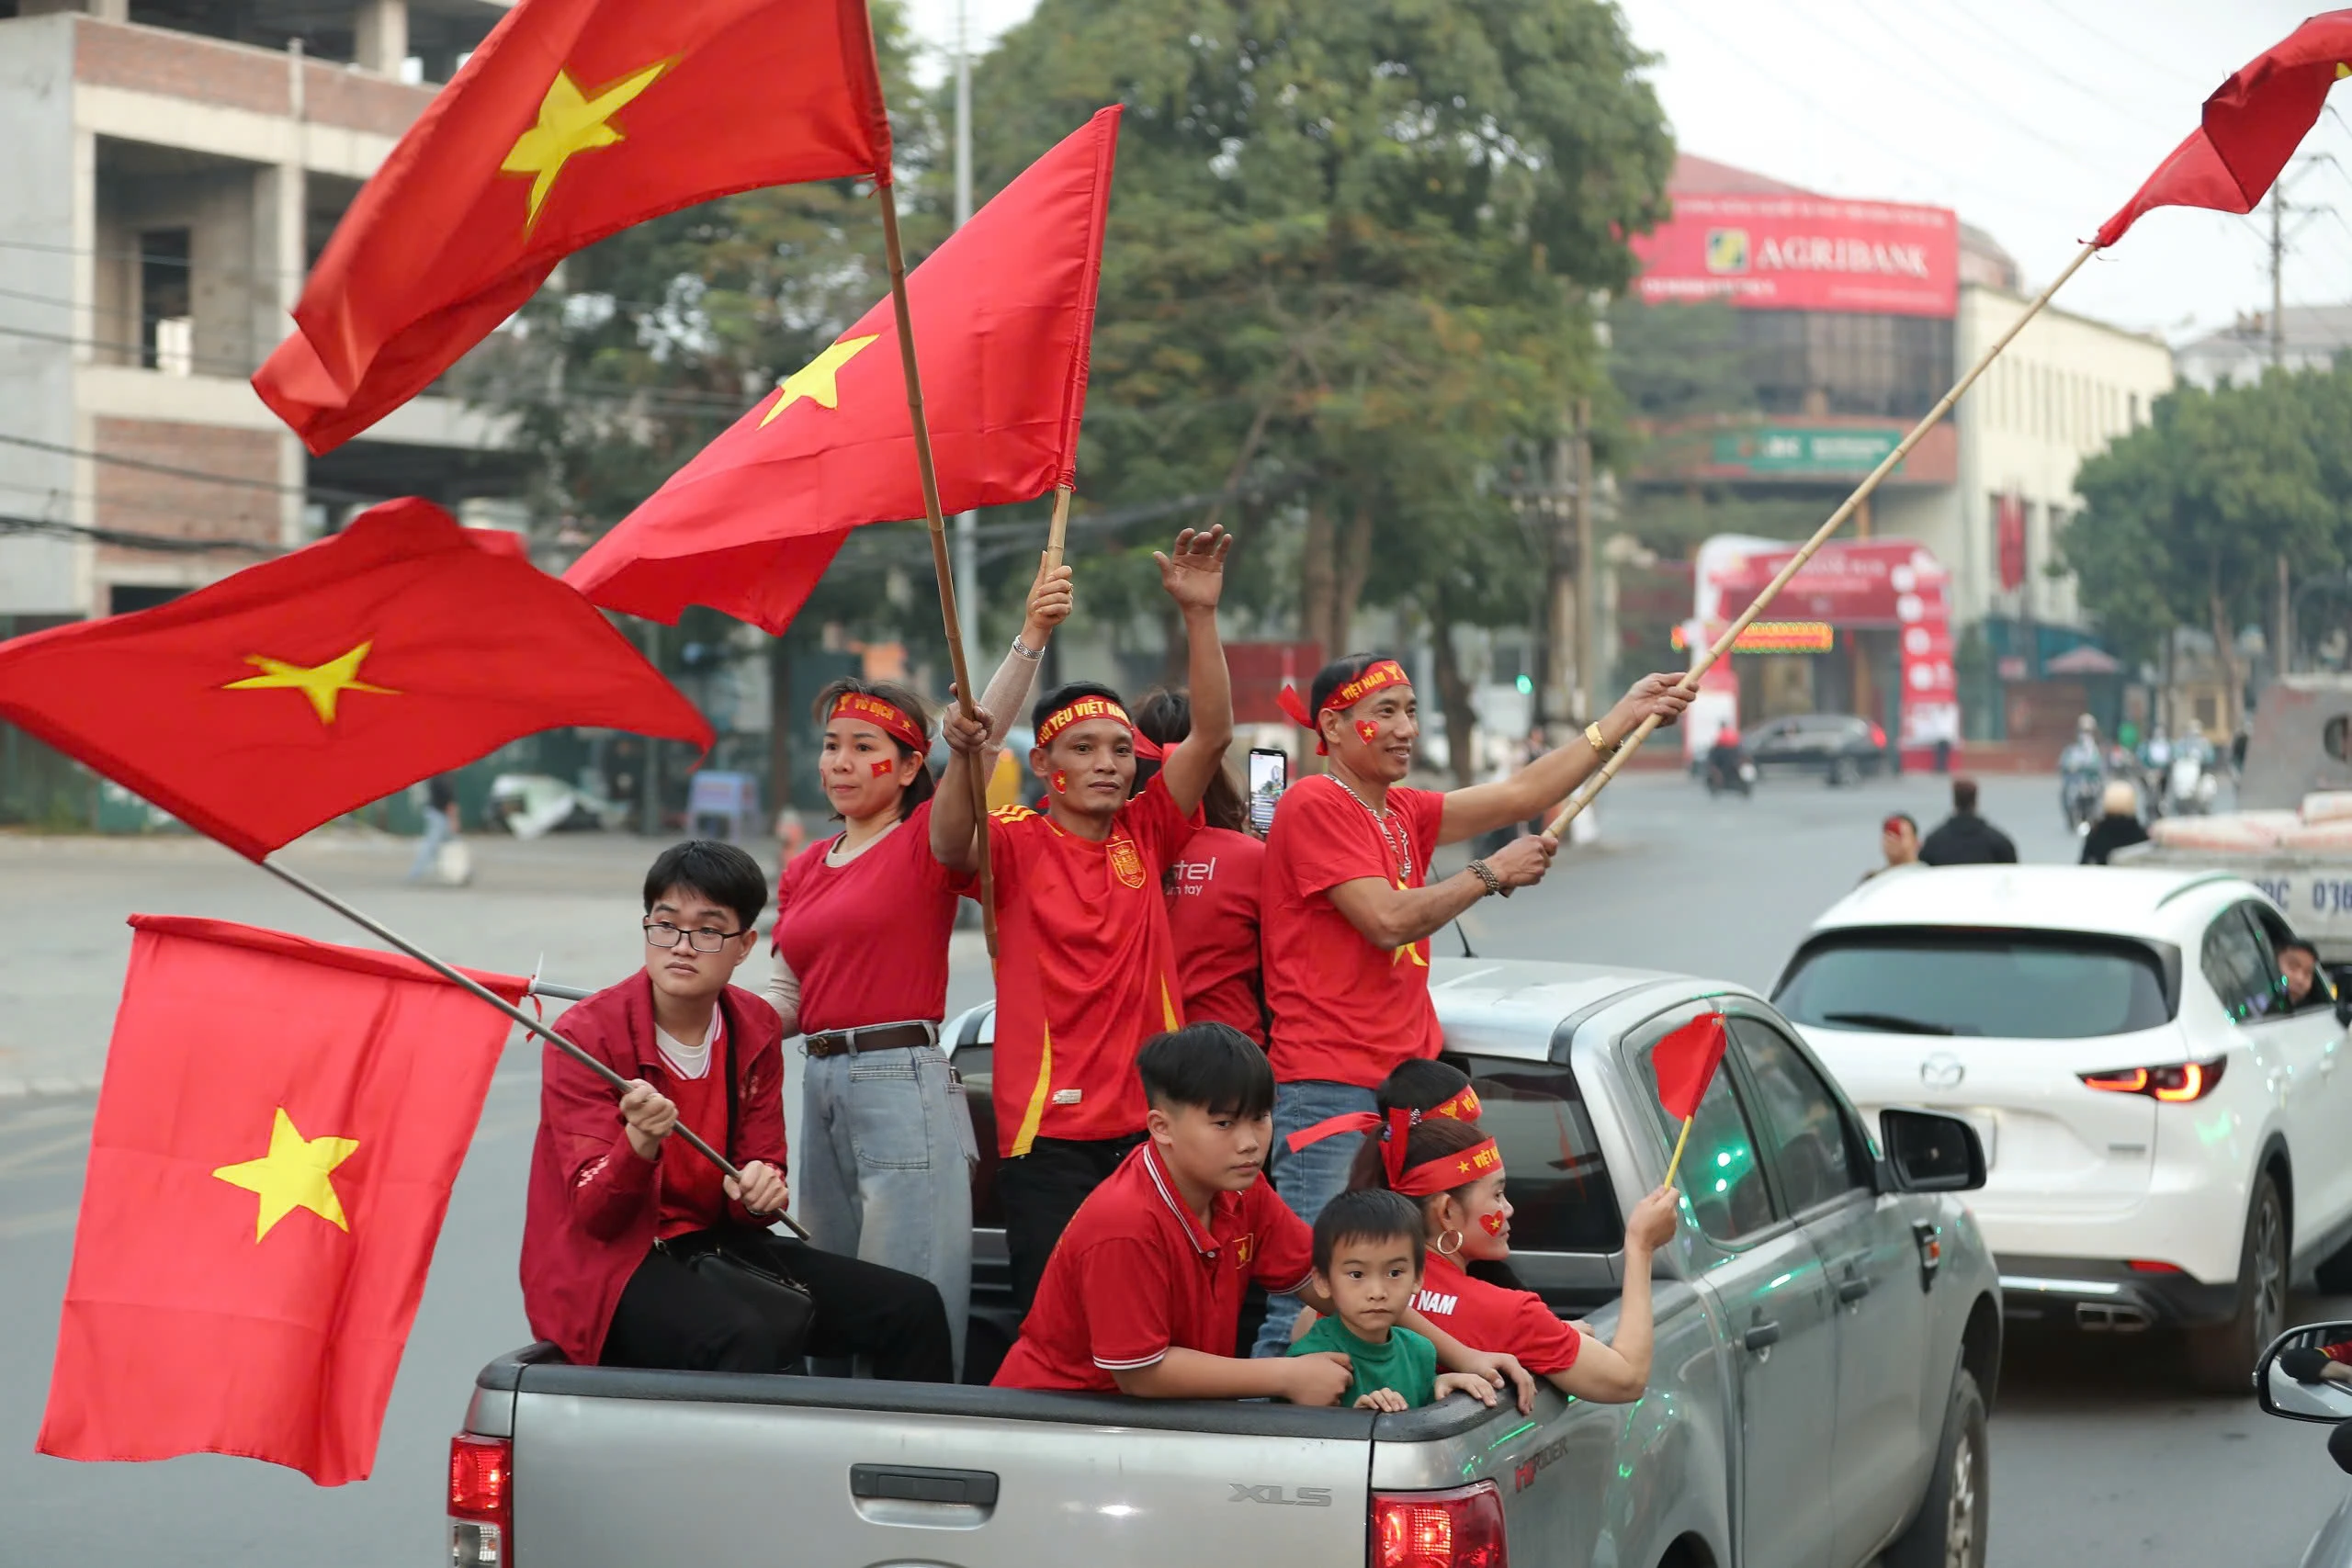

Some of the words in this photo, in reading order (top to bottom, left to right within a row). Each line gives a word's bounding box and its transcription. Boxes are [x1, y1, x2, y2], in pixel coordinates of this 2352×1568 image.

[1757, 235, 1928, 278] AGRIBANK
[1361, 671, 1386, 689] NAM
[1049, 707, 1073, 731] YÊU
[1074, 698, 1104, 717] VIỆT
[1184, 884, 1203, 897] tay
[1416, 1289, 1459, 1315] NAM
[1227, 1483, 1332, 1507] XLS
